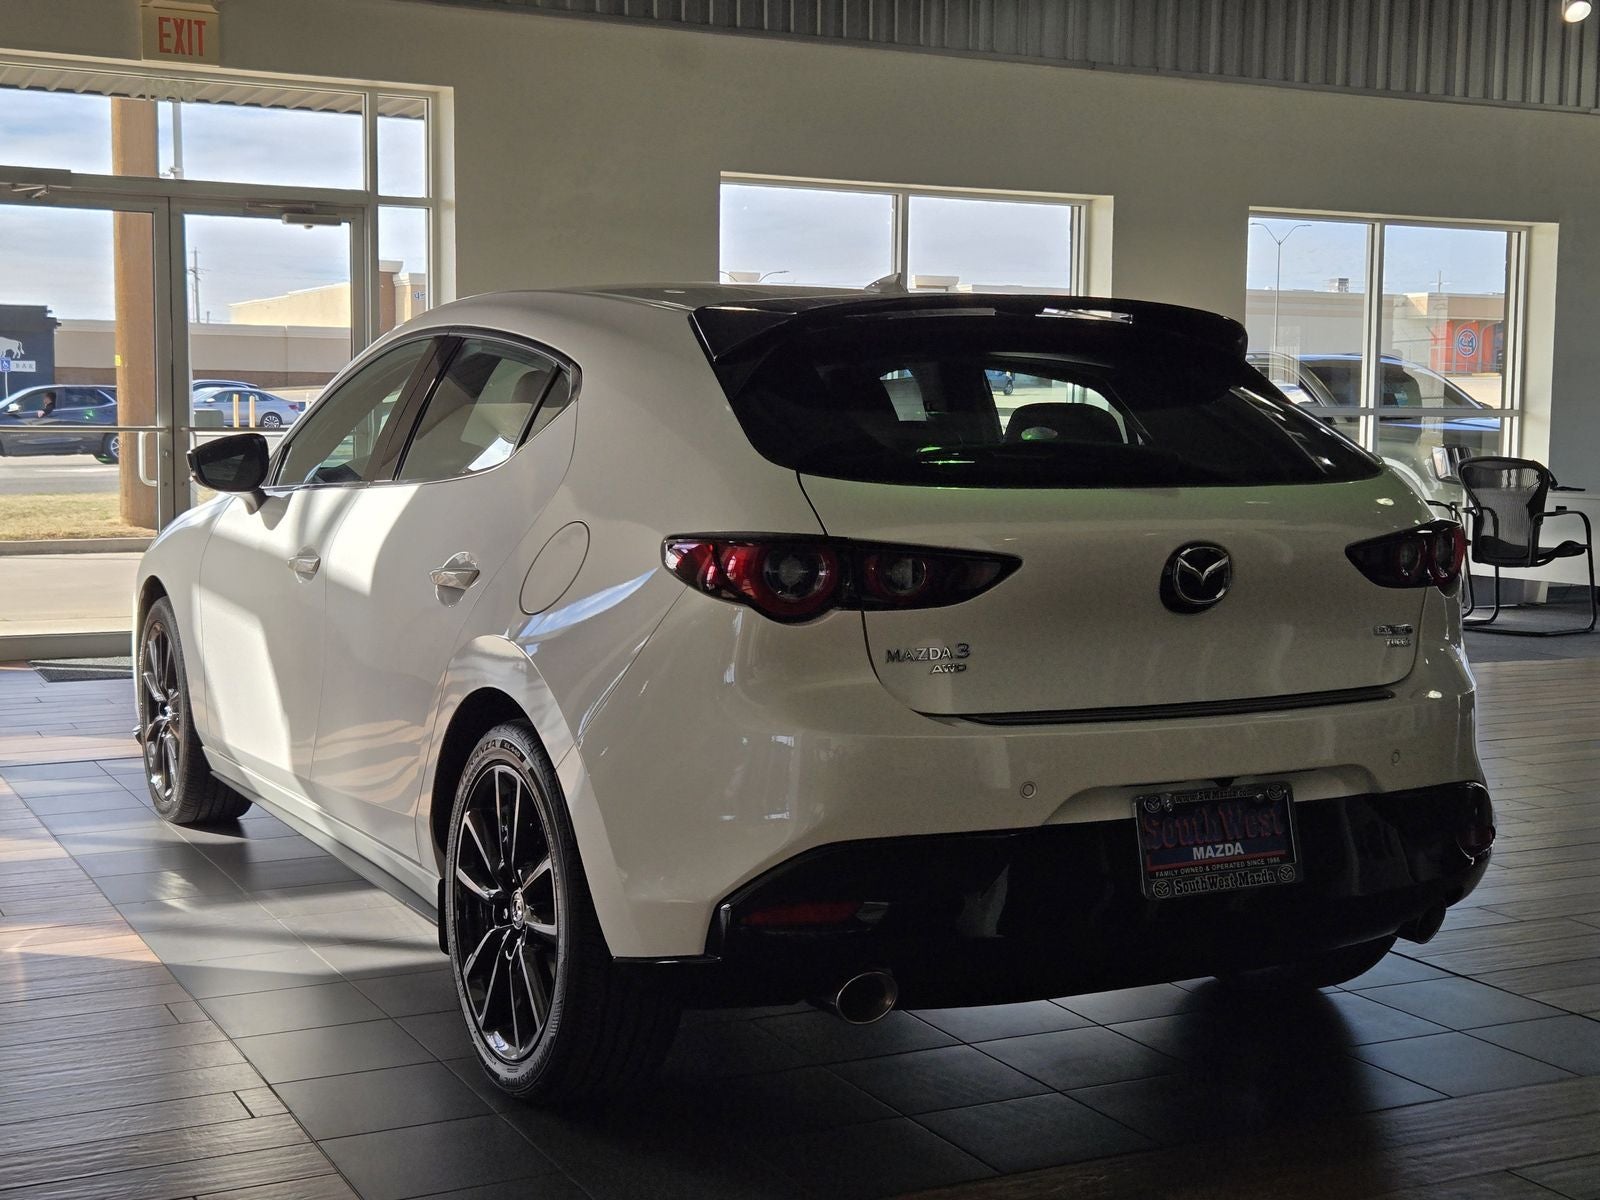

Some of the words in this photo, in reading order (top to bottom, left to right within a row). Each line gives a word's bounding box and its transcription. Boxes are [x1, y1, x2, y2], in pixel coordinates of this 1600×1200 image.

[158, 16, 207, 57] EXIT
[930, 663, 967, 674] AWD
[1143, 802, 1283, 849] SouthWest
[1192, 842, 1245, 861] MAZDA
[1155, 869, 1179, 878] FAMILY
[1180, 866, 1204, 875] OWNED
[1211, 861, 1245, 871] OPERATED
[1246, 859, 1265, 867] SINCE
[1174, 873, 1236, 895] SouthWest
[1238, 869, 1276, 888] Mazda
